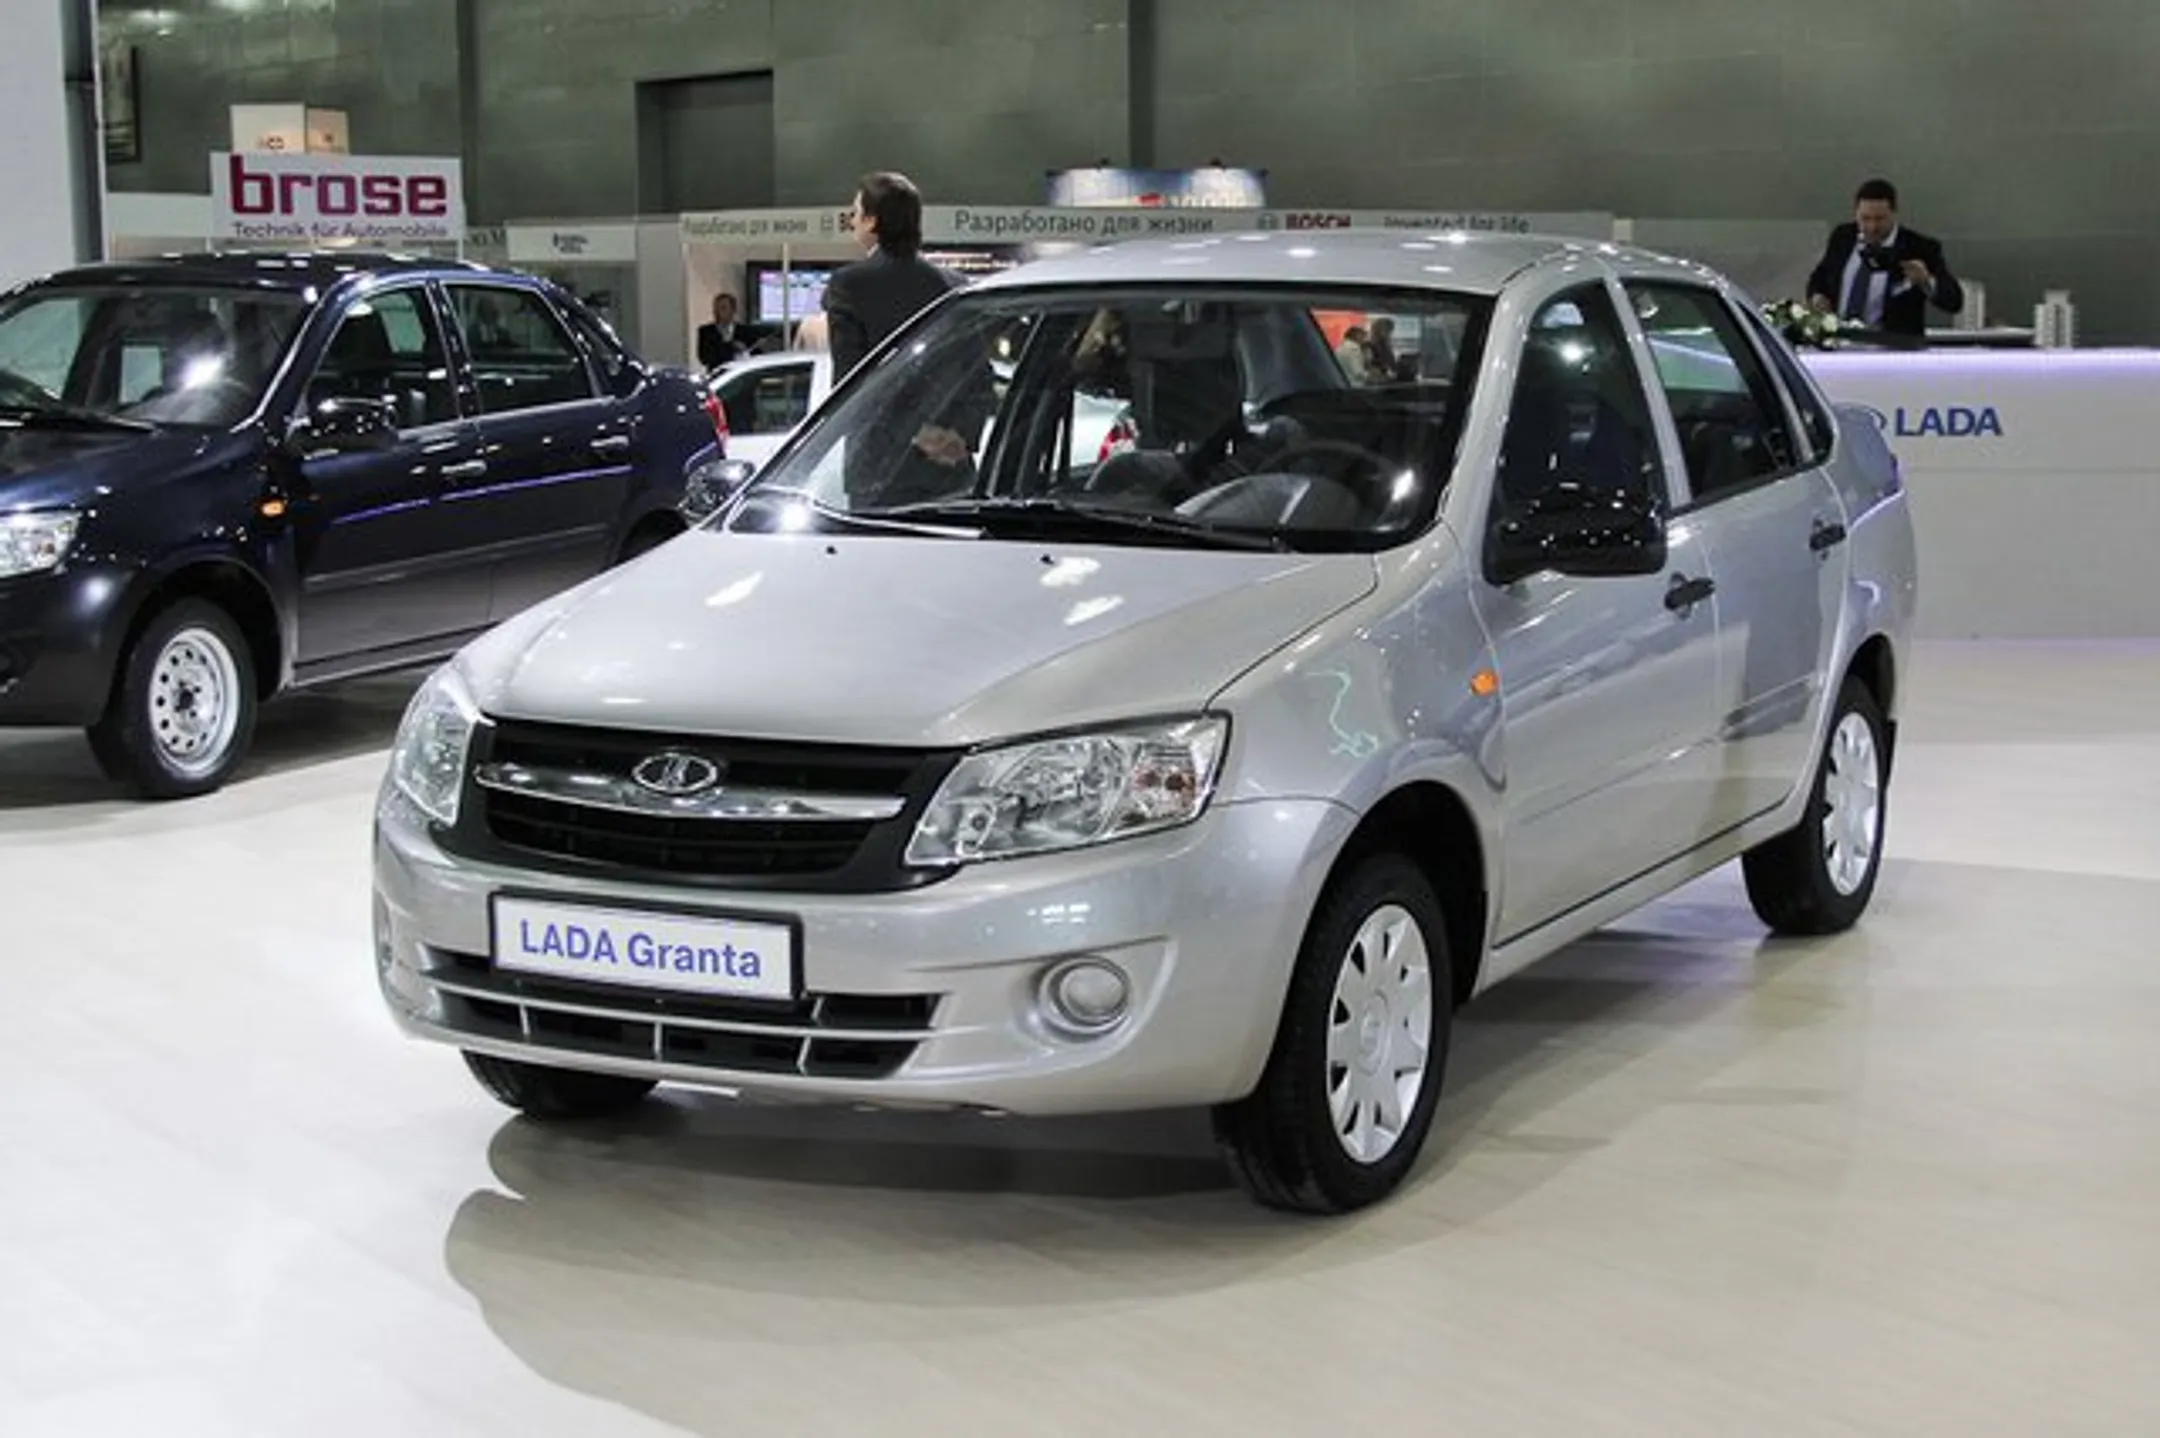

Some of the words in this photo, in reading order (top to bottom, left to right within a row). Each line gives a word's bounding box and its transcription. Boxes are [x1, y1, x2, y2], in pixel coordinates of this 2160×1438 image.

[230, 154, 448, 216] brose
[232, 221, 304, 237] Technik
[311, 221, 337, 237] für
[341, 221, 448, 237] Automobile
[954, 209, 1095, 236] Разработано
[1101, 217, 1140, 235] для
[1148, 216, 1215, 233] жизни
[1285, 212, 1352, 230] BOSCH
[1894, 407, 2003, 436] LADA
[519, 919, 618, 964] LADA
[627, 933, 761, 977] Granta
